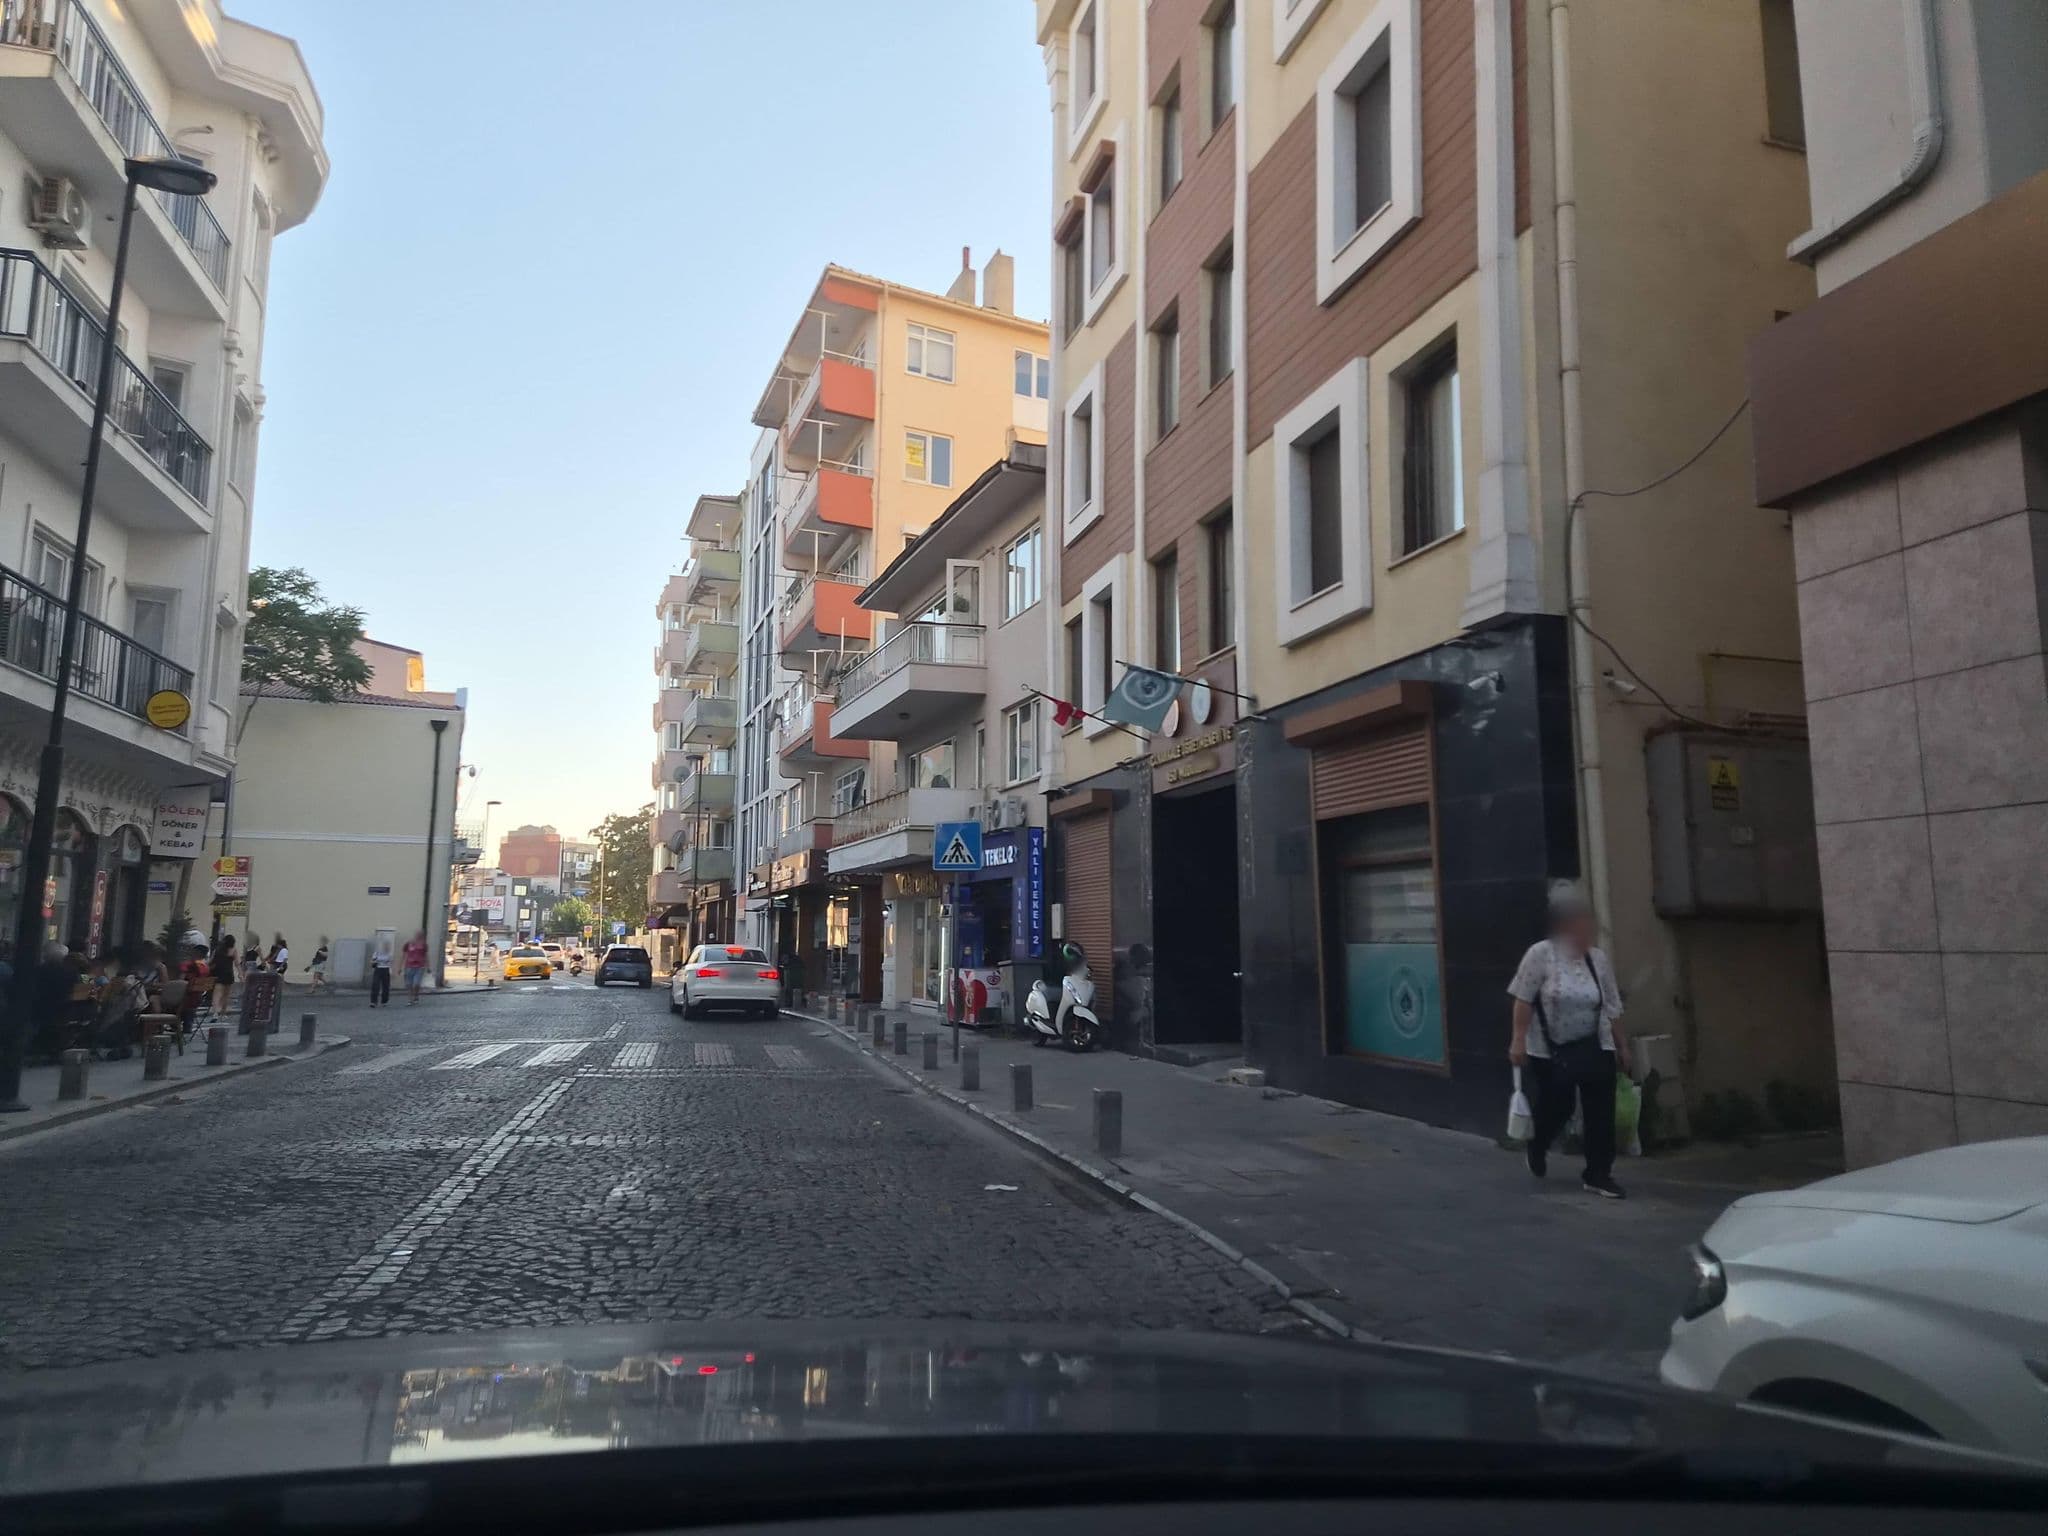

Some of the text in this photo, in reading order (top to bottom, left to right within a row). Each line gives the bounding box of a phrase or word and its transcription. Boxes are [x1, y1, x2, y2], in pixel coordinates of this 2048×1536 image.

[161, 820, 198, 829] DÖNER
[160, 839, 194, 848] KEBAP
[985, 846, 1008, 866] TEKEL
[476, 899, 502, 907] TROYA
[1032, 935, 1039, 945] 2
